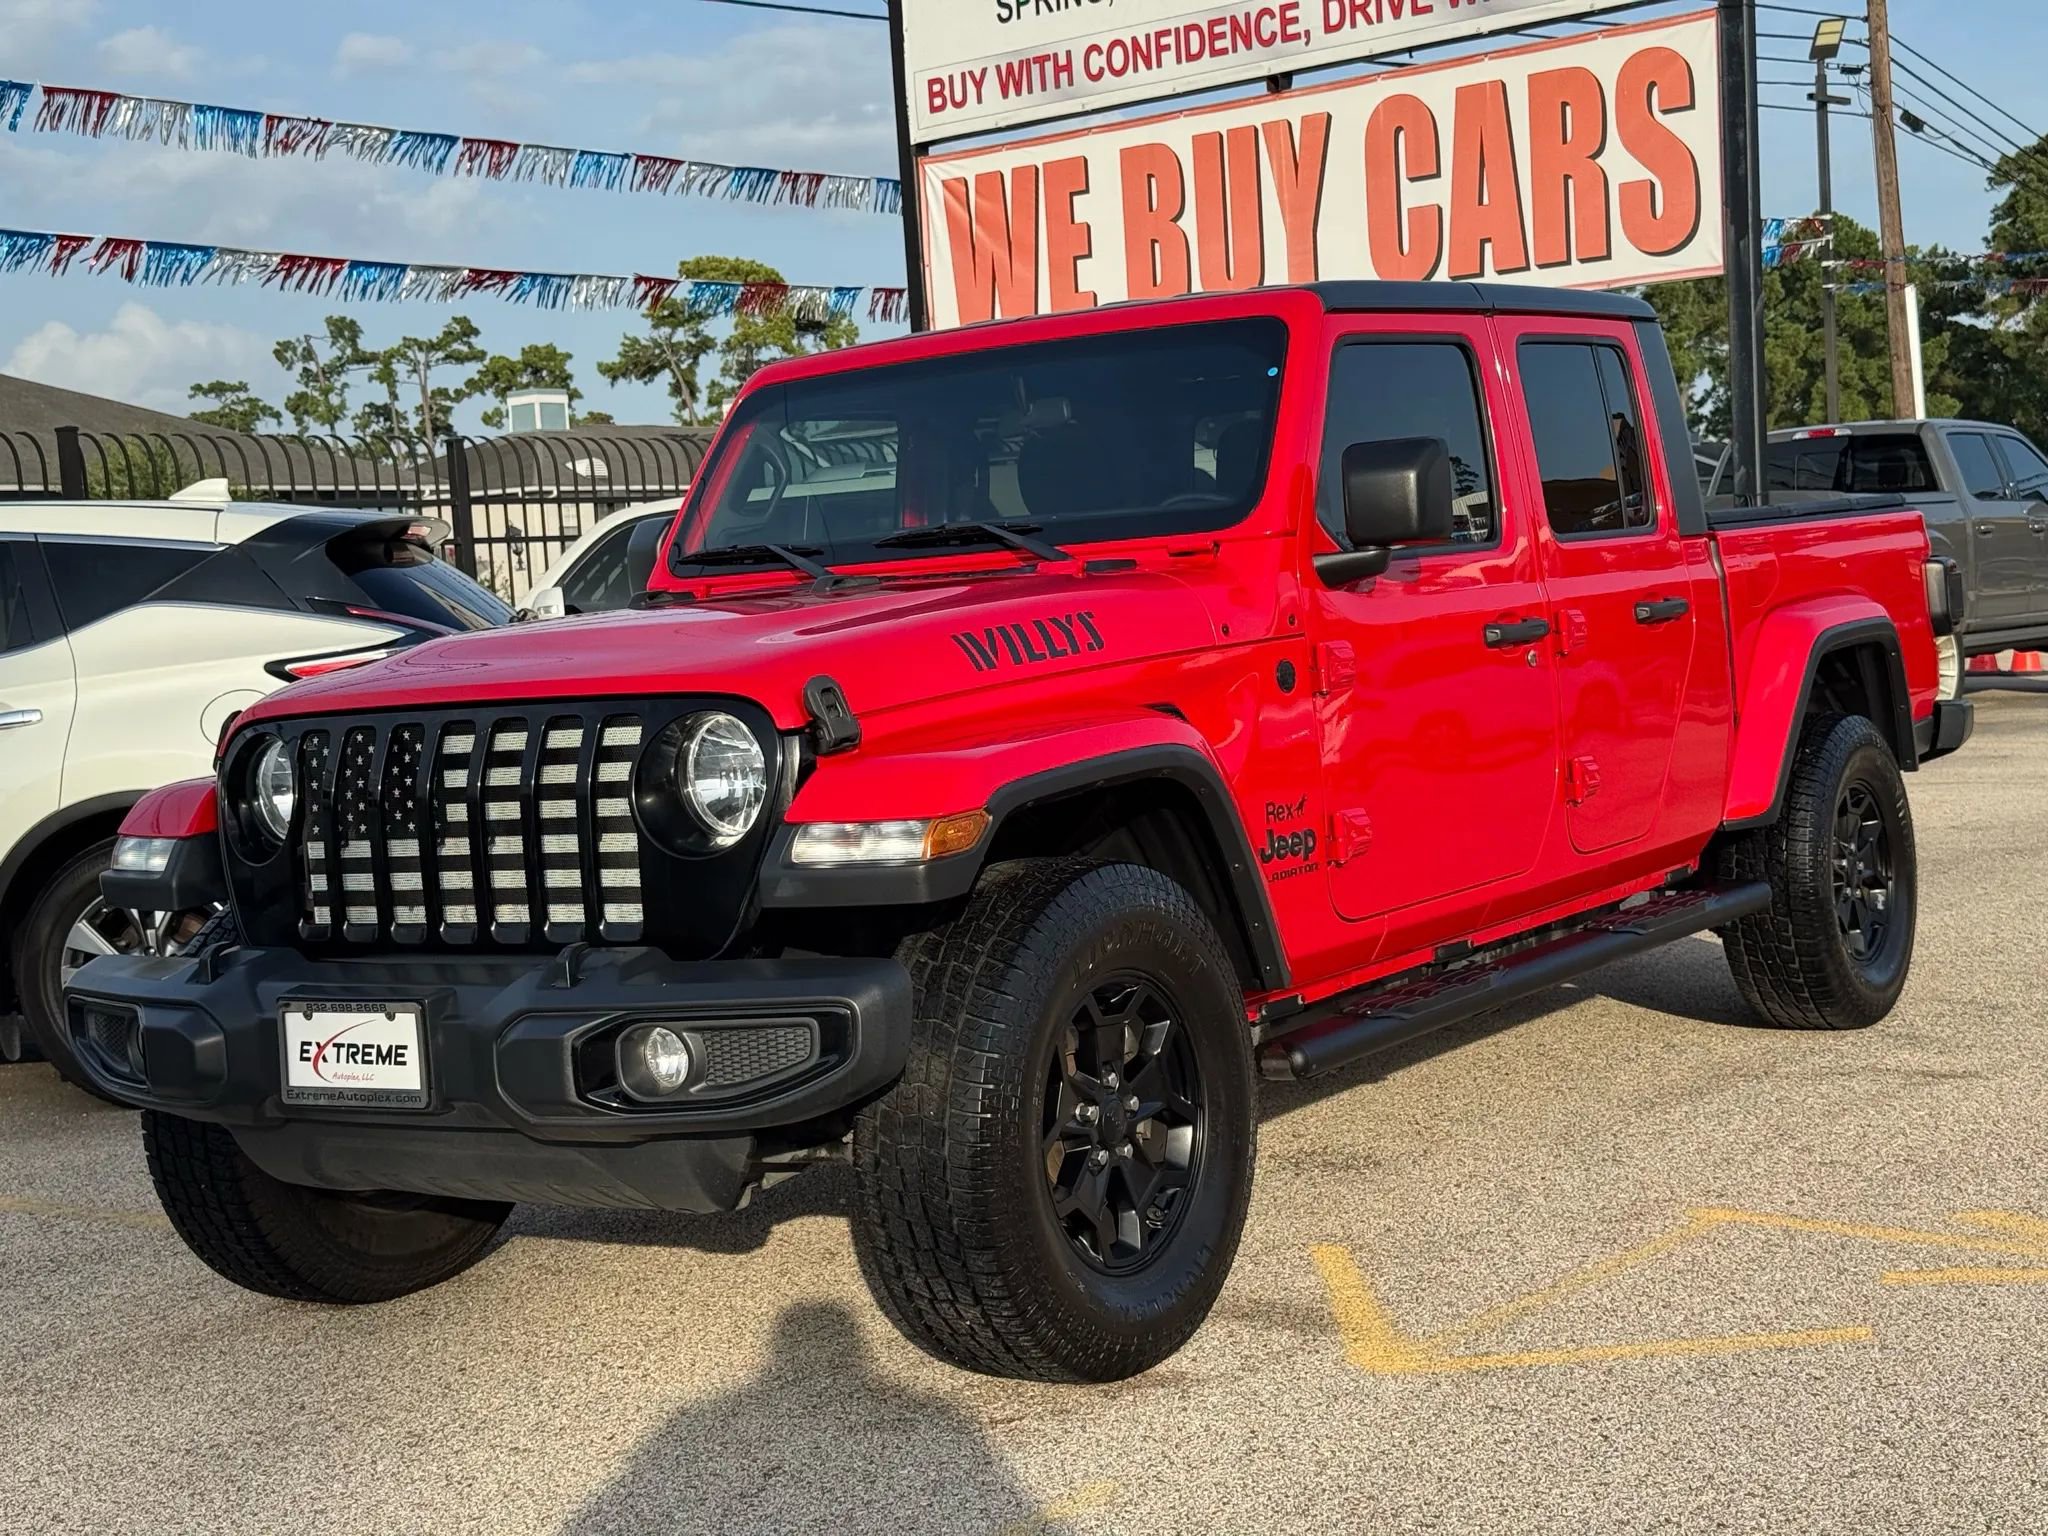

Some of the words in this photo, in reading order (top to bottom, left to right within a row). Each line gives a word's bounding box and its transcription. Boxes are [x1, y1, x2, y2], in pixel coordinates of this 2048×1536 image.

[927, 67, 987, 113] BUY
[995, 50, 1074, 99] WITH
[1083, 1, 1311, 82] CONFIDENCE,
[940, 156, 1098, 326] WE
[1120, 112, 1332, 297] BUY
[1364, 46, 1701, 282] CARS
[952, 611, 1105, 671] WILLYS
[1260, 828, 1316, 864] Jeep
[299, 1040, 408, 1066] EXTREME
[362, 1073, 375, 1081] LLC
[286, 1089, 422, 1103] ExtremeAutoplex.com
